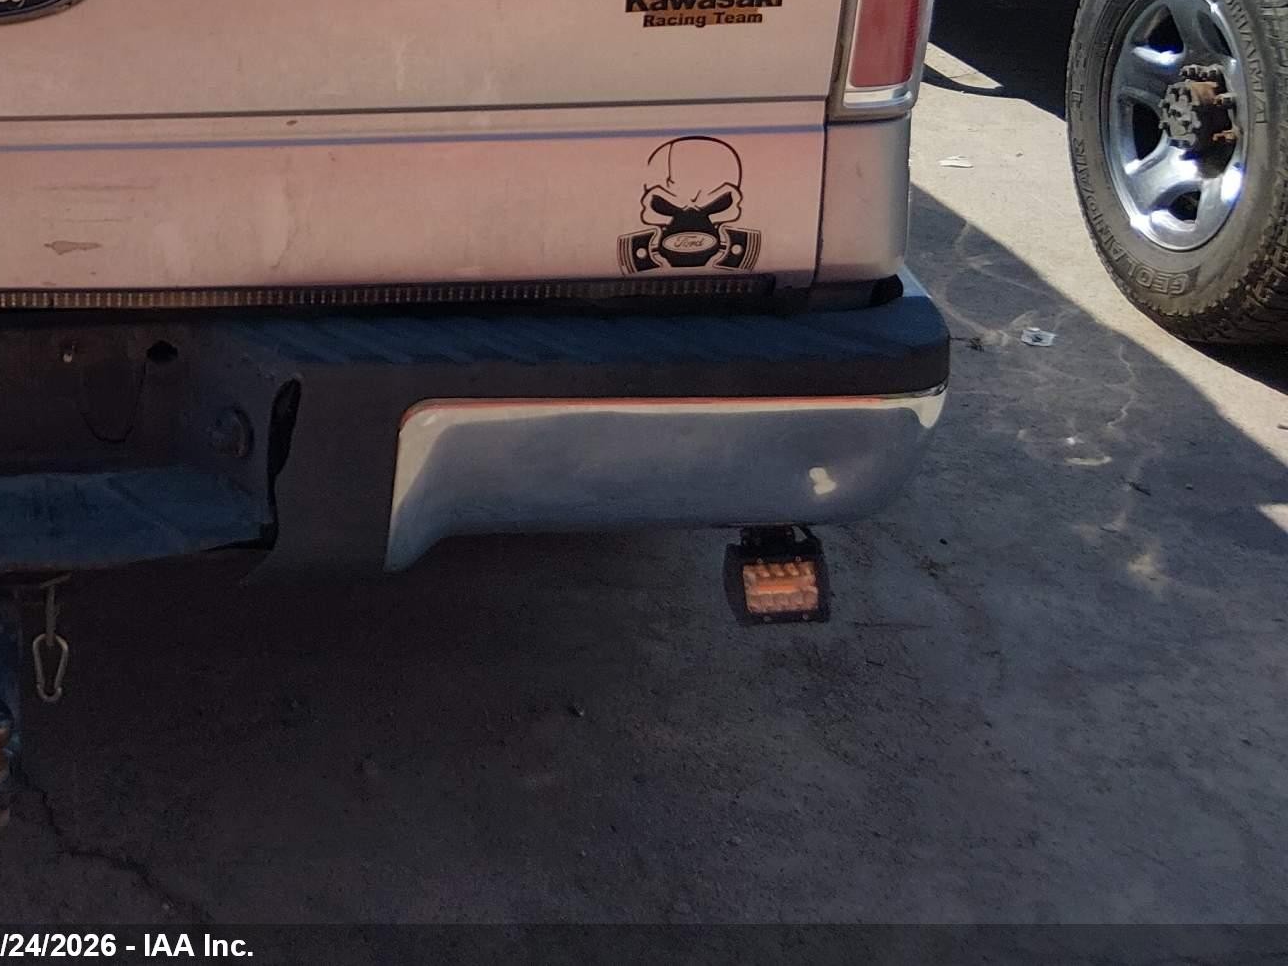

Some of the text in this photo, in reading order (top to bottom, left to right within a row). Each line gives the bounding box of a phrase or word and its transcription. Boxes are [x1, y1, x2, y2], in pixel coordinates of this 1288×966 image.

[643, 11, 763, 28] Racing Team
[673, 235, 705, 248] Ford
